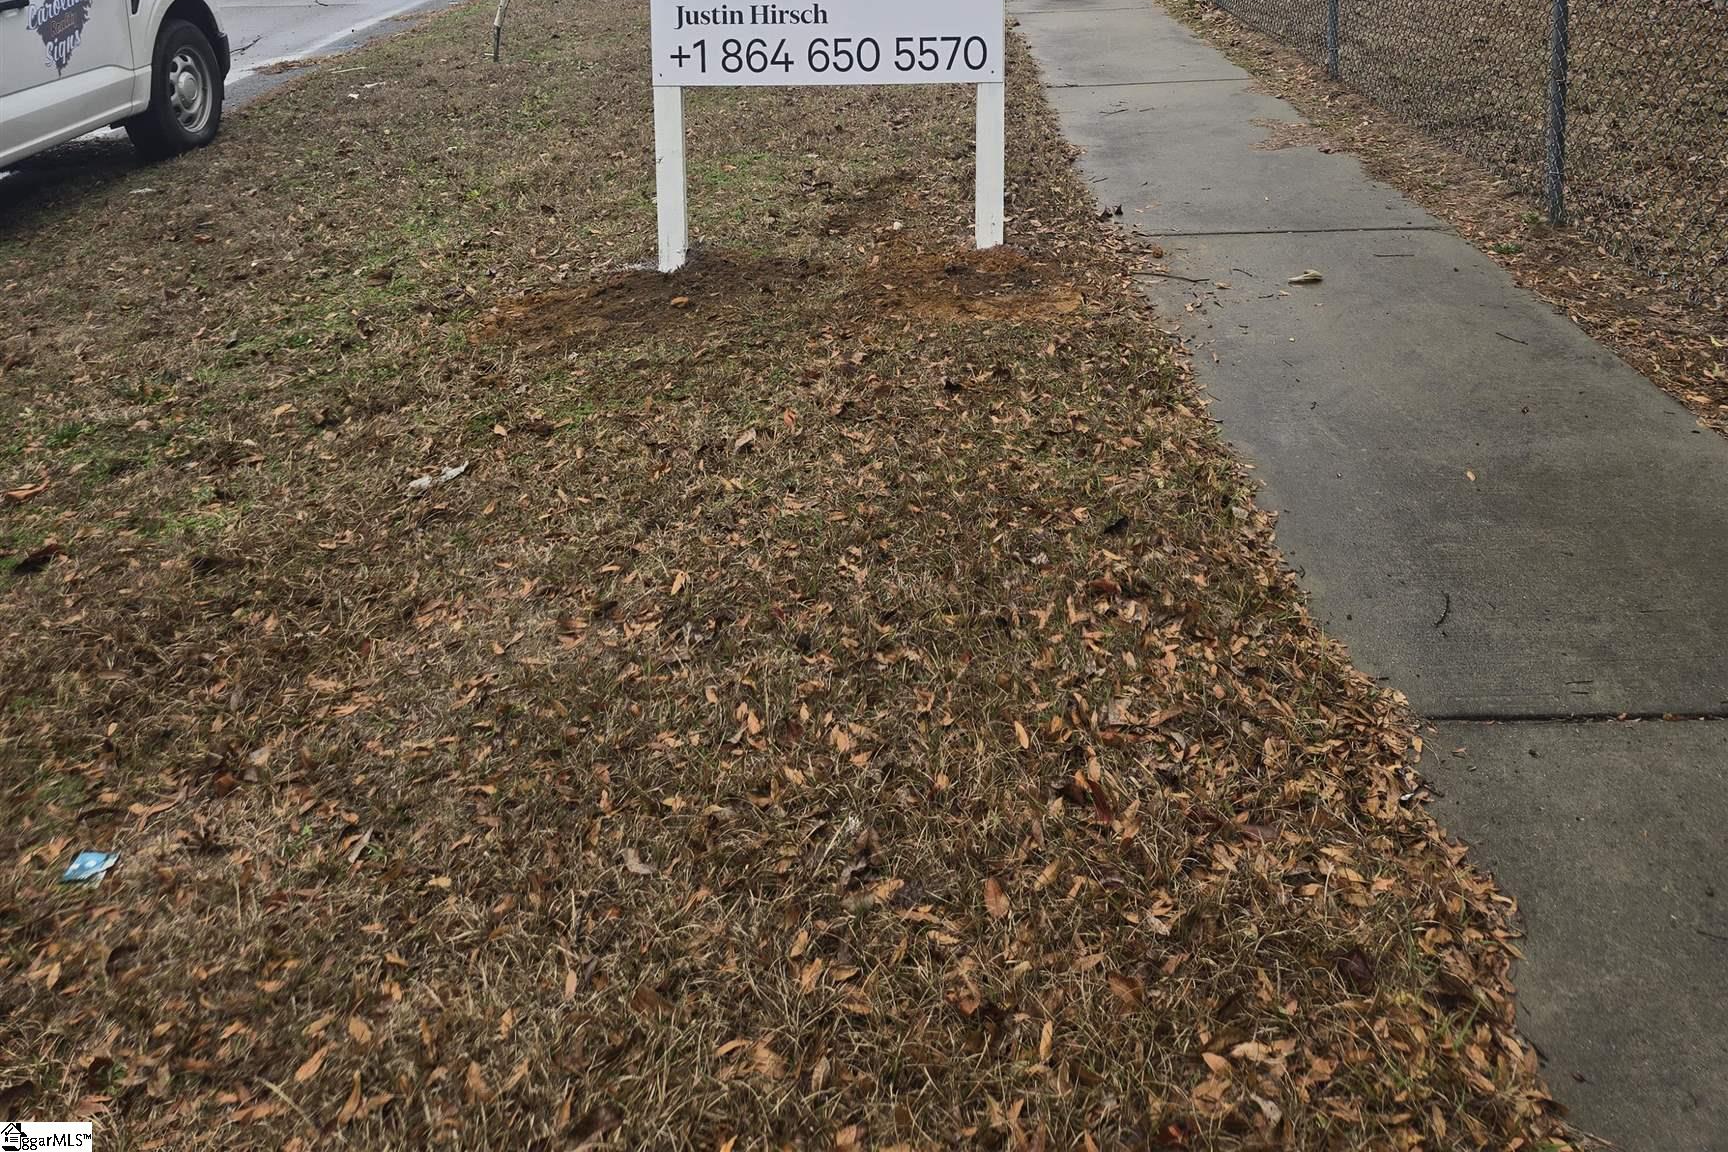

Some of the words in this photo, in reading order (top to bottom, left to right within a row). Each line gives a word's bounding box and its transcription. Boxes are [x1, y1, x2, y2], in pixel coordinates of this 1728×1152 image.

[674, 4, 745, 30] Justin
[750, 3, 828, 25] Hirsch
[44, 29, 81, 67] Signs
[669, 39, 706, 73] +1
[721, 38, 795, 74] 864
[807, 37, 881, 73] 650
[894, 35, 988, 72] 5570
